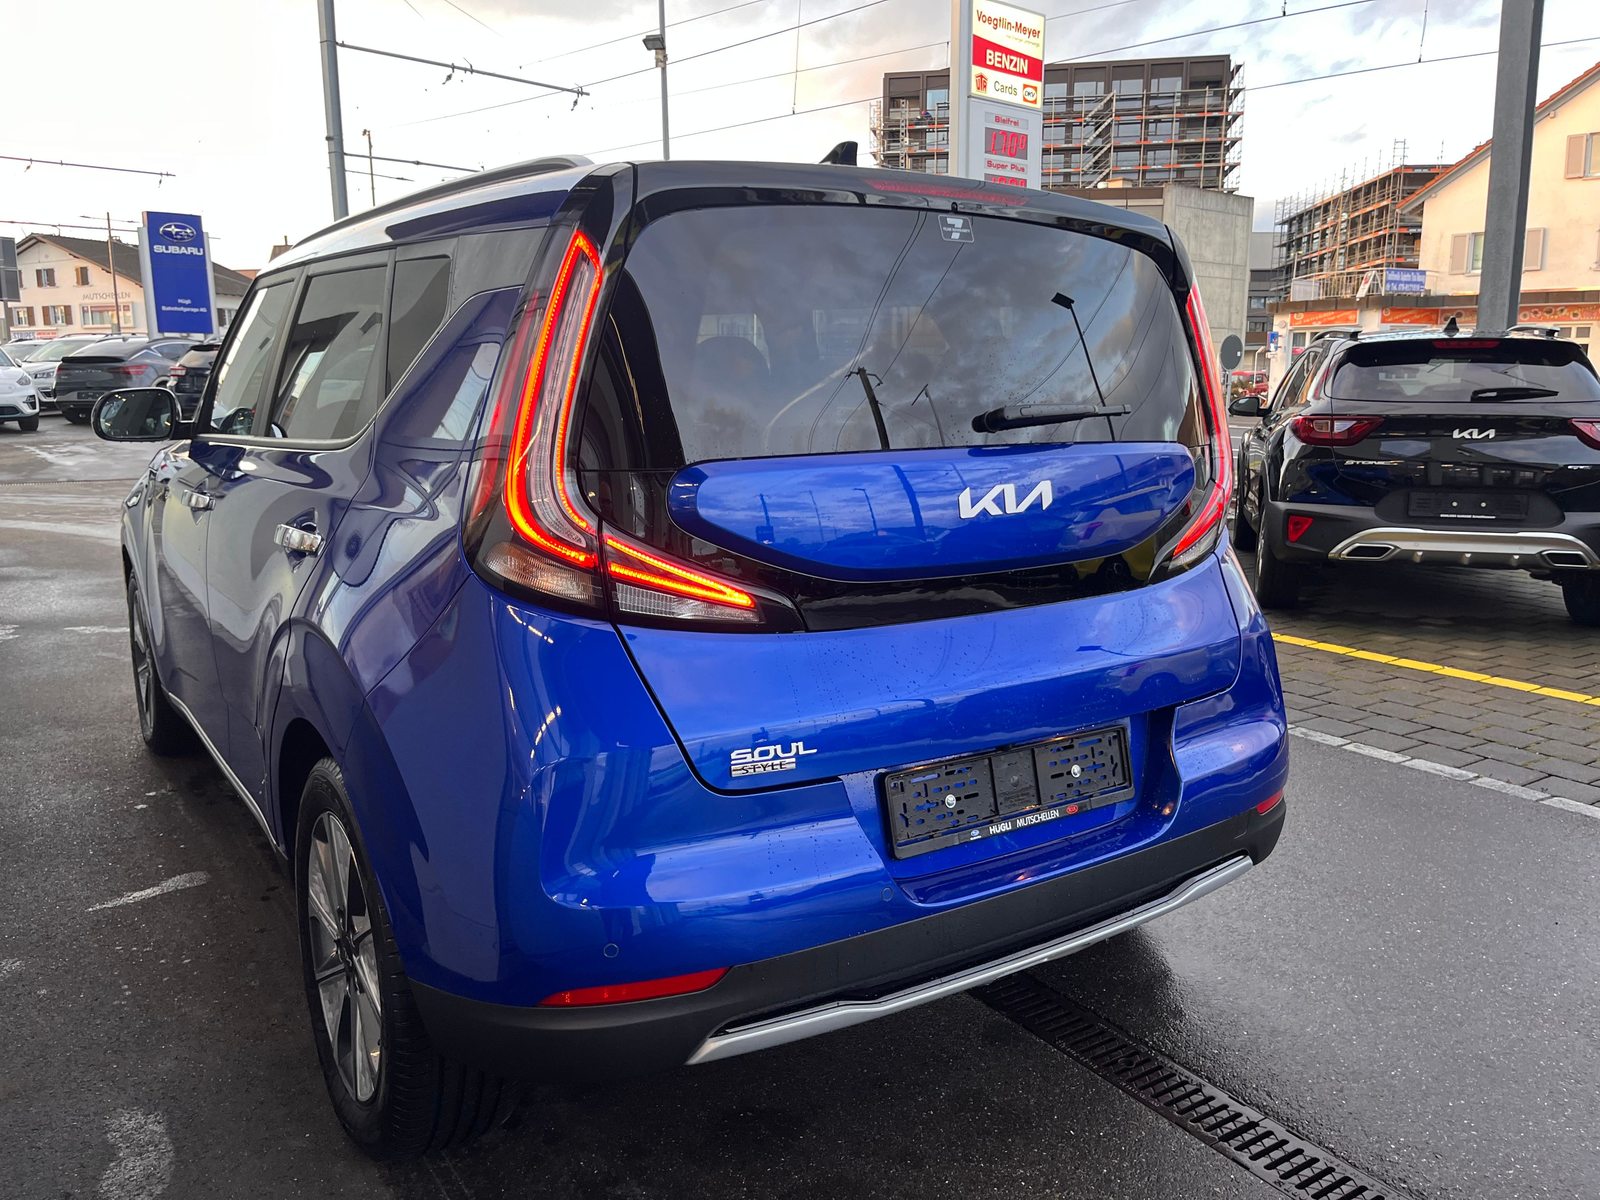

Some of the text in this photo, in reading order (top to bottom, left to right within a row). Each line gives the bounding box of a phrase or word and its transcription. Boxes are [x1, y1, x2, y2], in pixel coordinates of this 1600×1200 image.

[976, 9, 1041, 39] Voegtlin-Meyer
[986, 48, 1028, 75] BENZIN
[993, 80, 1018, 97] Cards
[986, 160, 1025, 173] Super Plus
[153, 244, 204, 256] SUBARU
[1452, 428, 1496, 440] KIA
[958, 479, 1053, 519] KIA
[730, 741, 818, 765] SOUL
[741, 760, 788, 775] STYLE
[1016, 804, 1061, 829] MUTSCHELLEN
